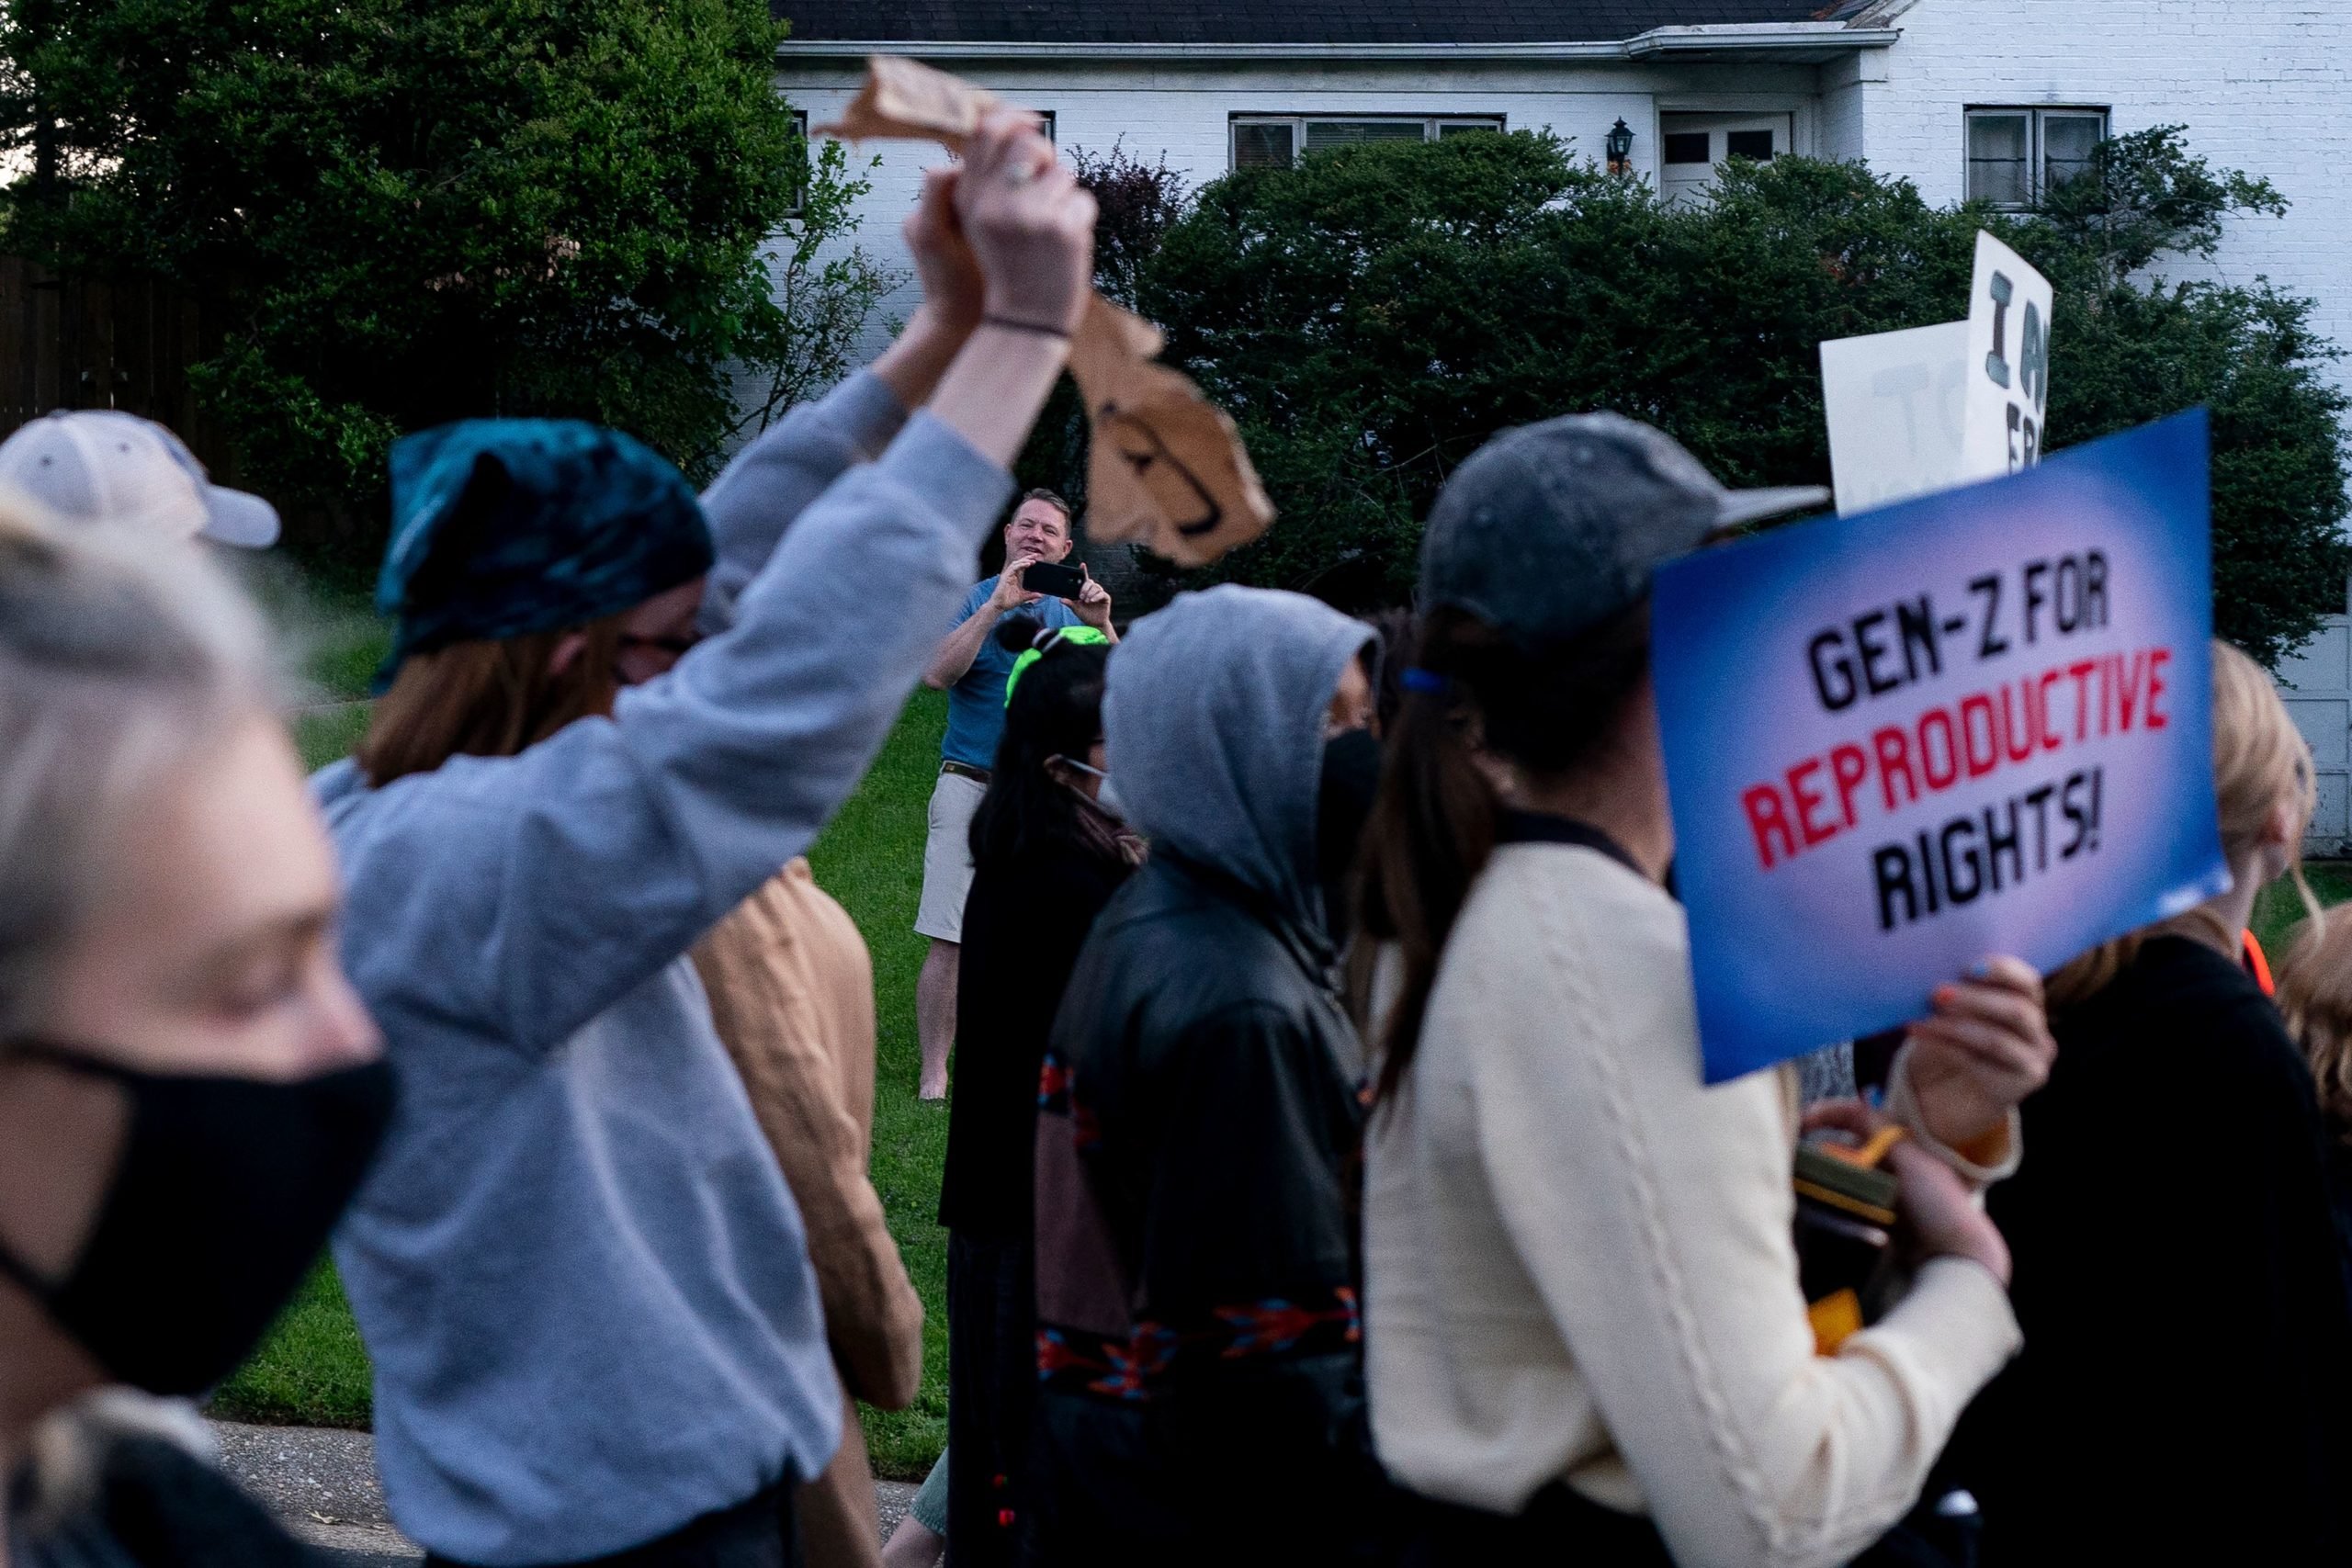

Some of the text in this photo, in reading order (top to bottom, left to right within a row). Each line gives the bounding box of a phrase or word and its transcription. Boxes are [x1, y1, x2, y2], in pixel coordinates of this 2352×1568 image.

[1986, 270, 2013, 390] I
[1807, 550, 2110, 713] GEN-Z FOR
[1739, 647, 2172, 871] REPRODUCTIVE
[1871, 766, 2105, 931] RIGHTS!
